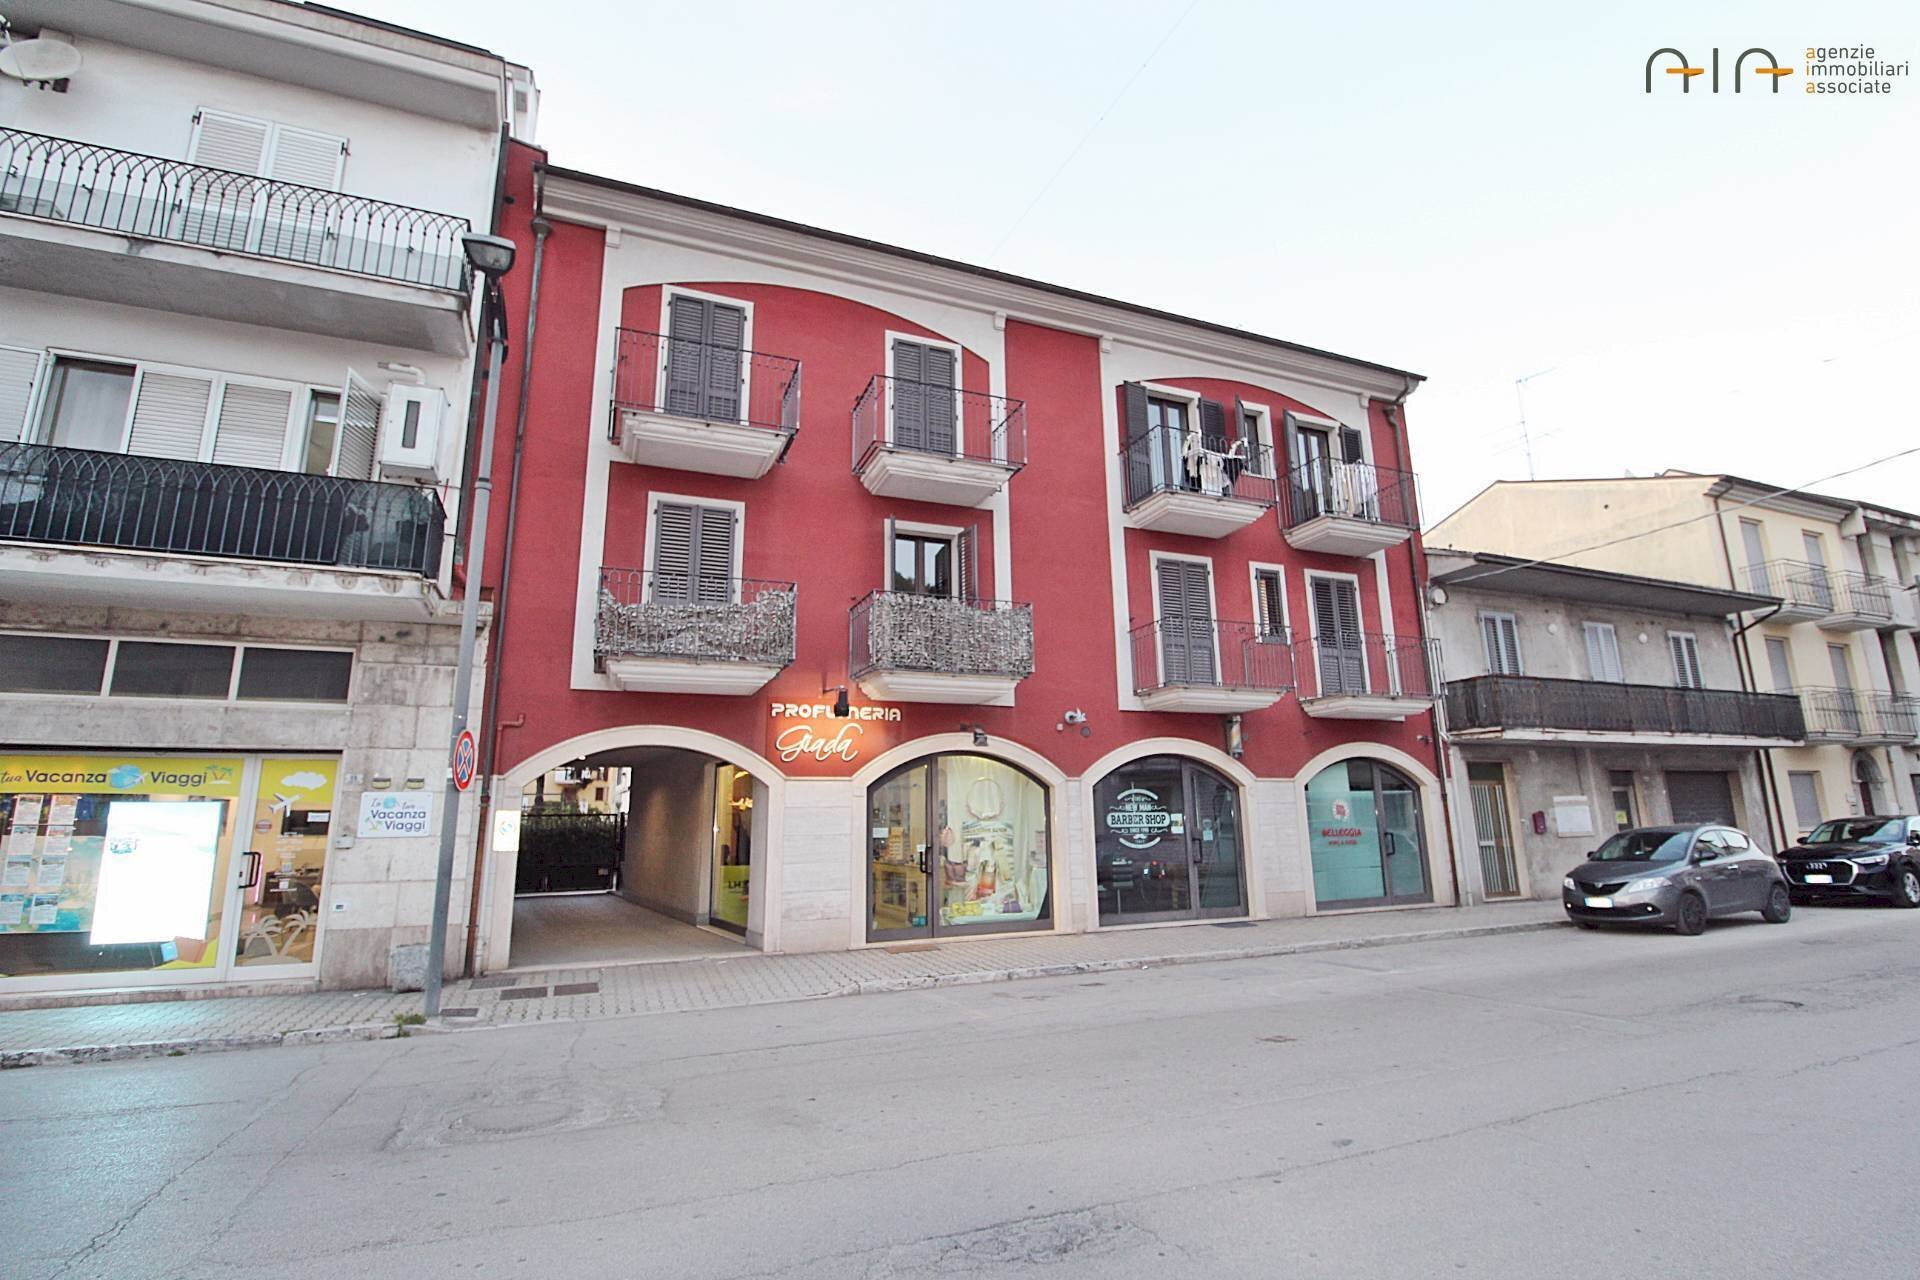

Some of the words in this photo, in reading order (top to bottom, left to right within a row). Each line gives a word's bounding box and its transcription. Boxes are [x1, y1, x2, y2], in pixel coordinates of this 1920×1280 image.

[775, 722, 864, 762] Giada
[26, 769, 107, 783] Vacanza
[150, 771, 208, 787] Viaggi
[371, 809, 426, 820] Vacanza
[1111, 814, 1144, 825] BARBER
[1145, 814, 1166, 825] SHOP
[385, 820, 426, 832] Viaggi
